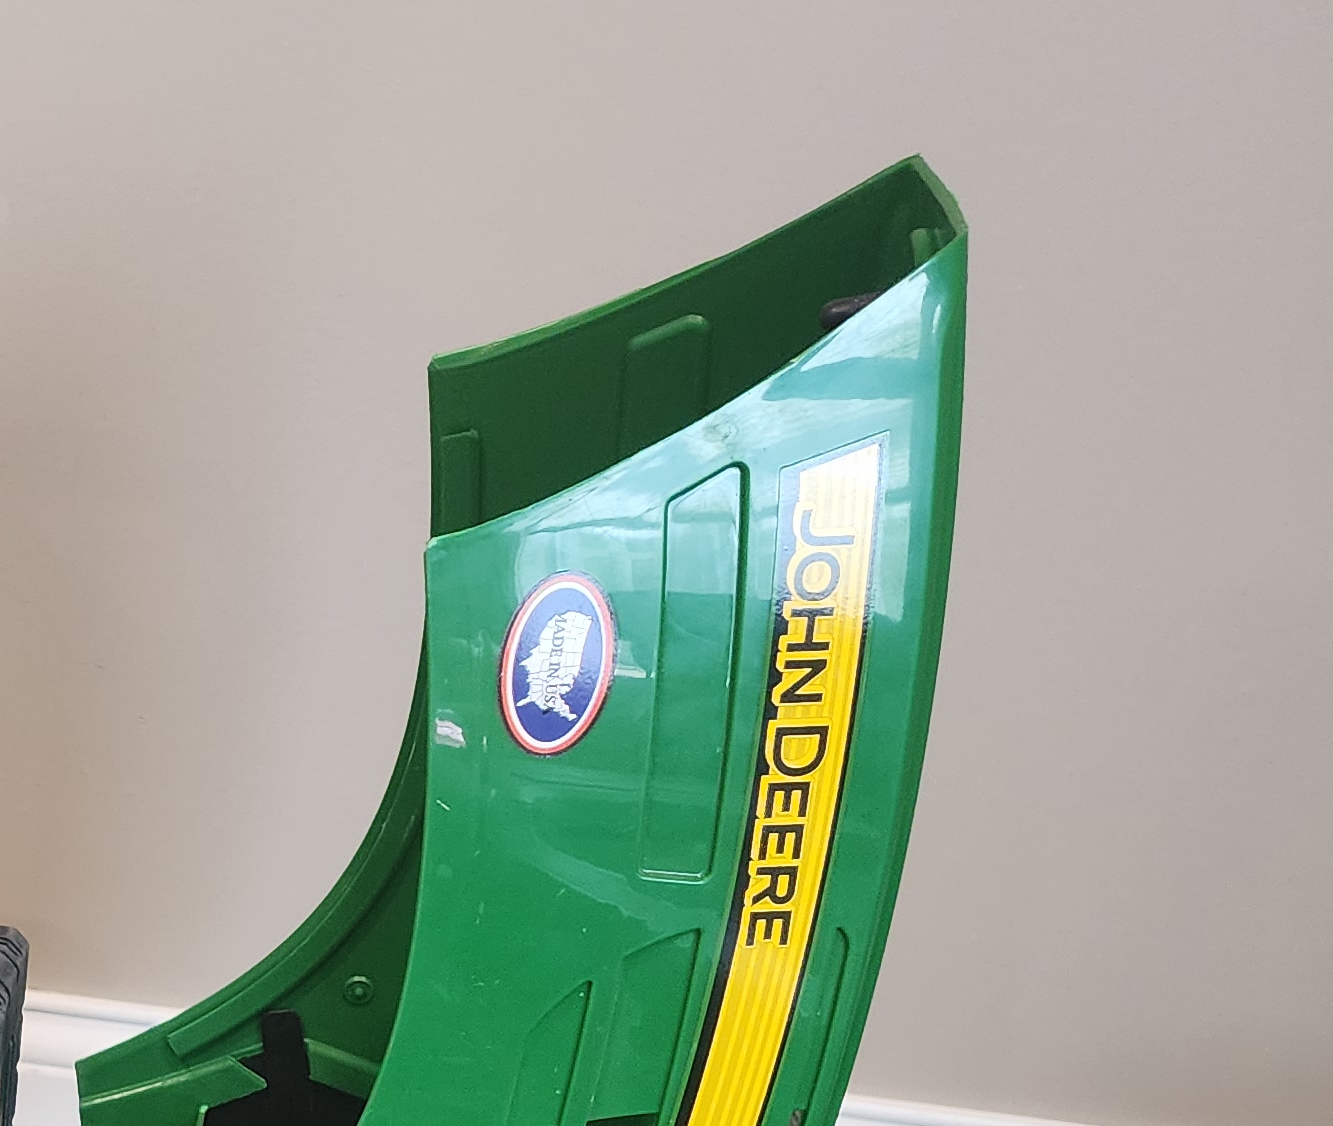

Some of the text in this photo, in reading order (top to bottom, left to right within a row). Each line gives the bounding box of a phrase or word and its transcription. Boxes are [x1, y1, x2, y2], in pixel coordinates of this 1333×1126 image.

[548, 662, 561, 678] IN
[745, 508, 855, 947] JOHN DEERE
